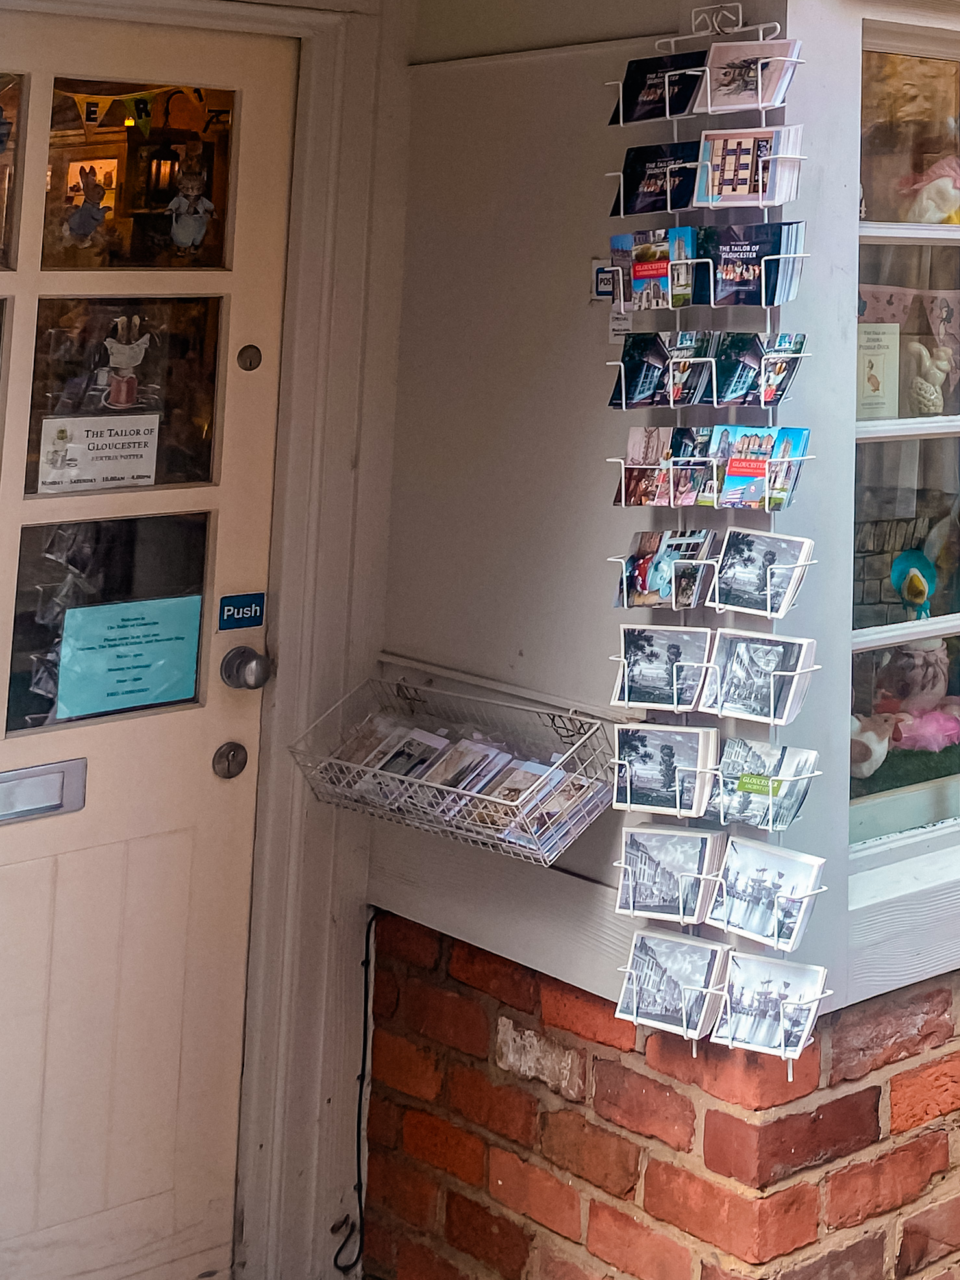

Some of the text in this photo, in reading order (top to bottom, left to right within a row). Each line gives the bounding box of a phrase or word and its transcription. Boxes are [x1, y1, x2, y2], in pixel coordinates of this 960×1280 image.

[599, 277, 613, 286] POS
[84, 427, 155, 439] THE TAILOR OF
[87, 441, 150, 452] GLOUCESTER
[223, 603, 260, 620] Push
